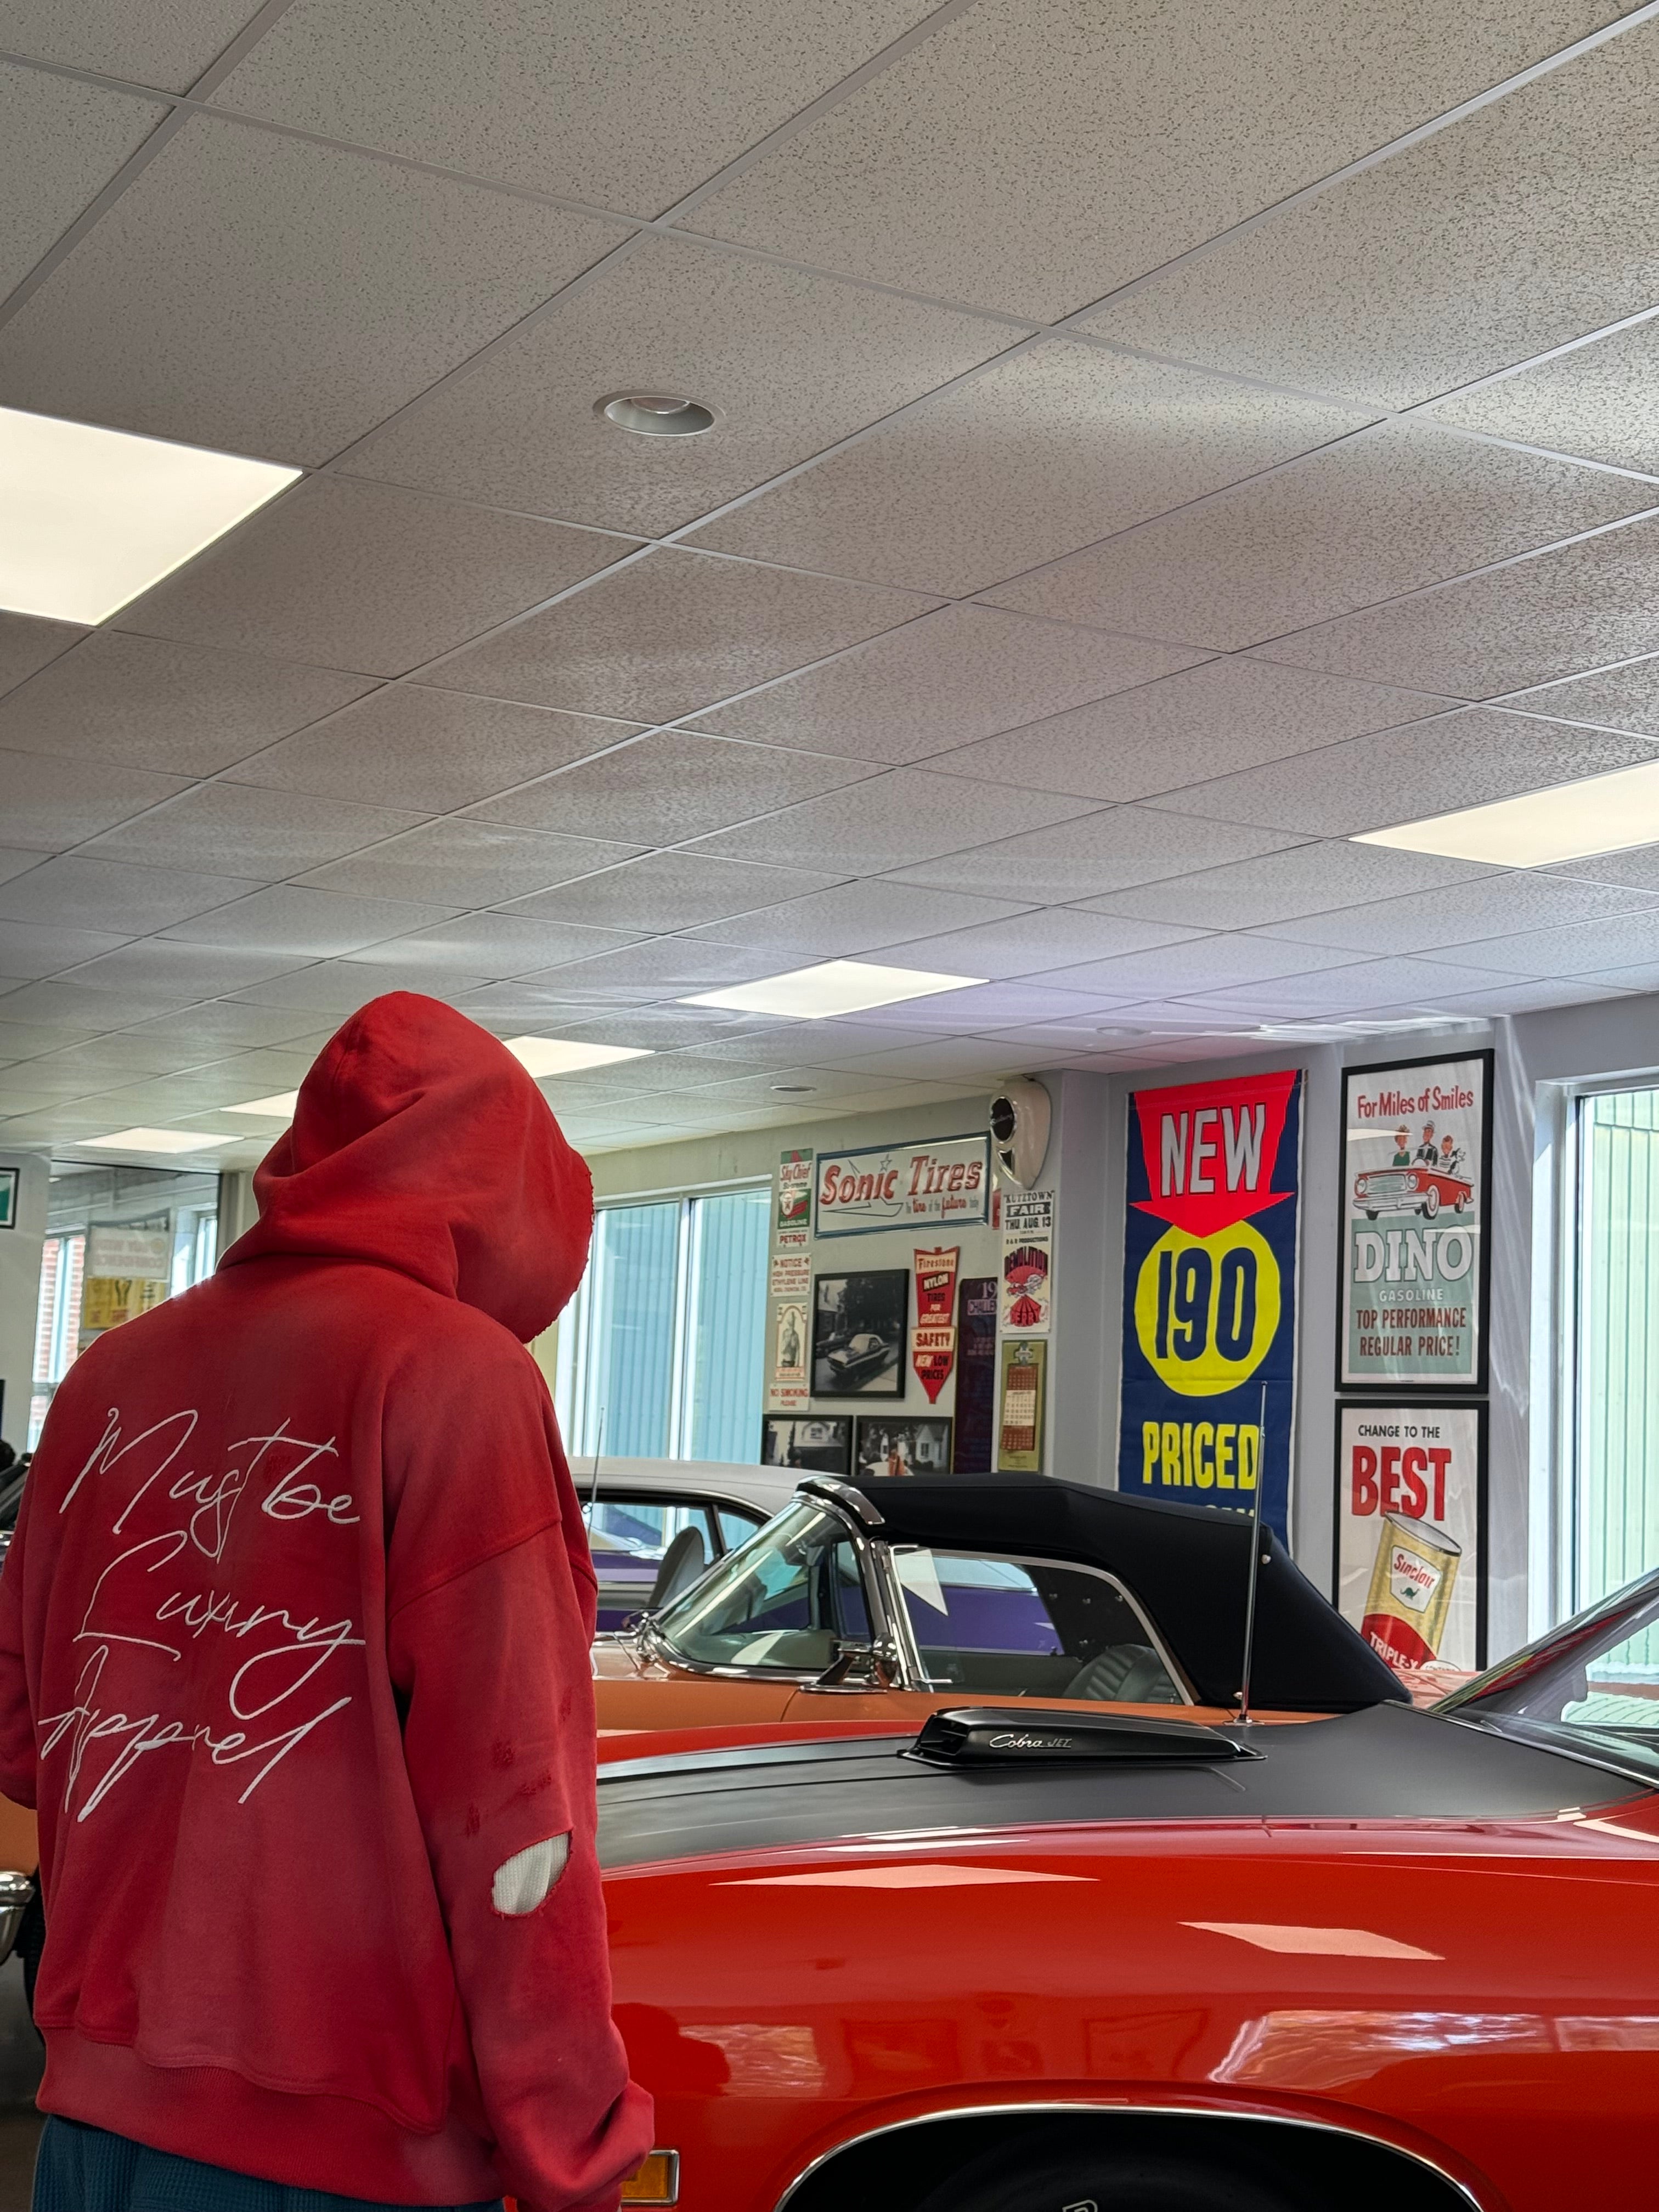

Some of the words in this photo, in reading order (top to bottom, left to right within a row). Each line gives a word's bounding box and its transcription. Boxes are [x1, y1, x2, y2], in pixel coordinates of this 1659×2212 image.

[1358, 1095, 1377, 1119] For
[1379, 1091, 1415, 1117] Miles
[1418, 1087, 1431, 1112] of
[1432, 1085, 1474, 1110] Smiles
[1161, 1103, 1266, 1197] NEW
[820, 1165, 899, 1205] Sonic
[907, 1155, 983, 1196] Tires
[1009, 1203, 1045, 1216] FAIR
[1042, 1216, 1052, 1228] 13
[918, 1258, 954, 1269] Firestone
[1353, 1224, 1472, 1283] DINO
[923, 1273, 949, 1290] NYLON
[1155, 1247, 1257, 1362] 190
[1379, 1288, 1444, 1303] GASOLINE
[1356, 1310, 1378, 1329] TOP
[1382, 1307, 1466, 1329] PERFORMANCE
[916, 1332, 951, 1347] SAFETY
[1359, 1336, 1413, 1357] REGULAR
[1418, 1336, 1460, 1356] PRICE!
[922, 1369, 944, 1380] PRICES
[1358, 1425, 1400, 1438] CHANGE
[1404, 1426, 1417, 1438] TO
[1421, 1426, 1440, 1438] THE
[1142, 1421, 1261, 1491] PRICED
[1351, 1445, 1452, 1521] BEST
[1393, 1553, 1435, 1589] Sinclair
[989, 1733, 1042, 1748] Cobra
[1047, 1738, 1072, 1748] JET
